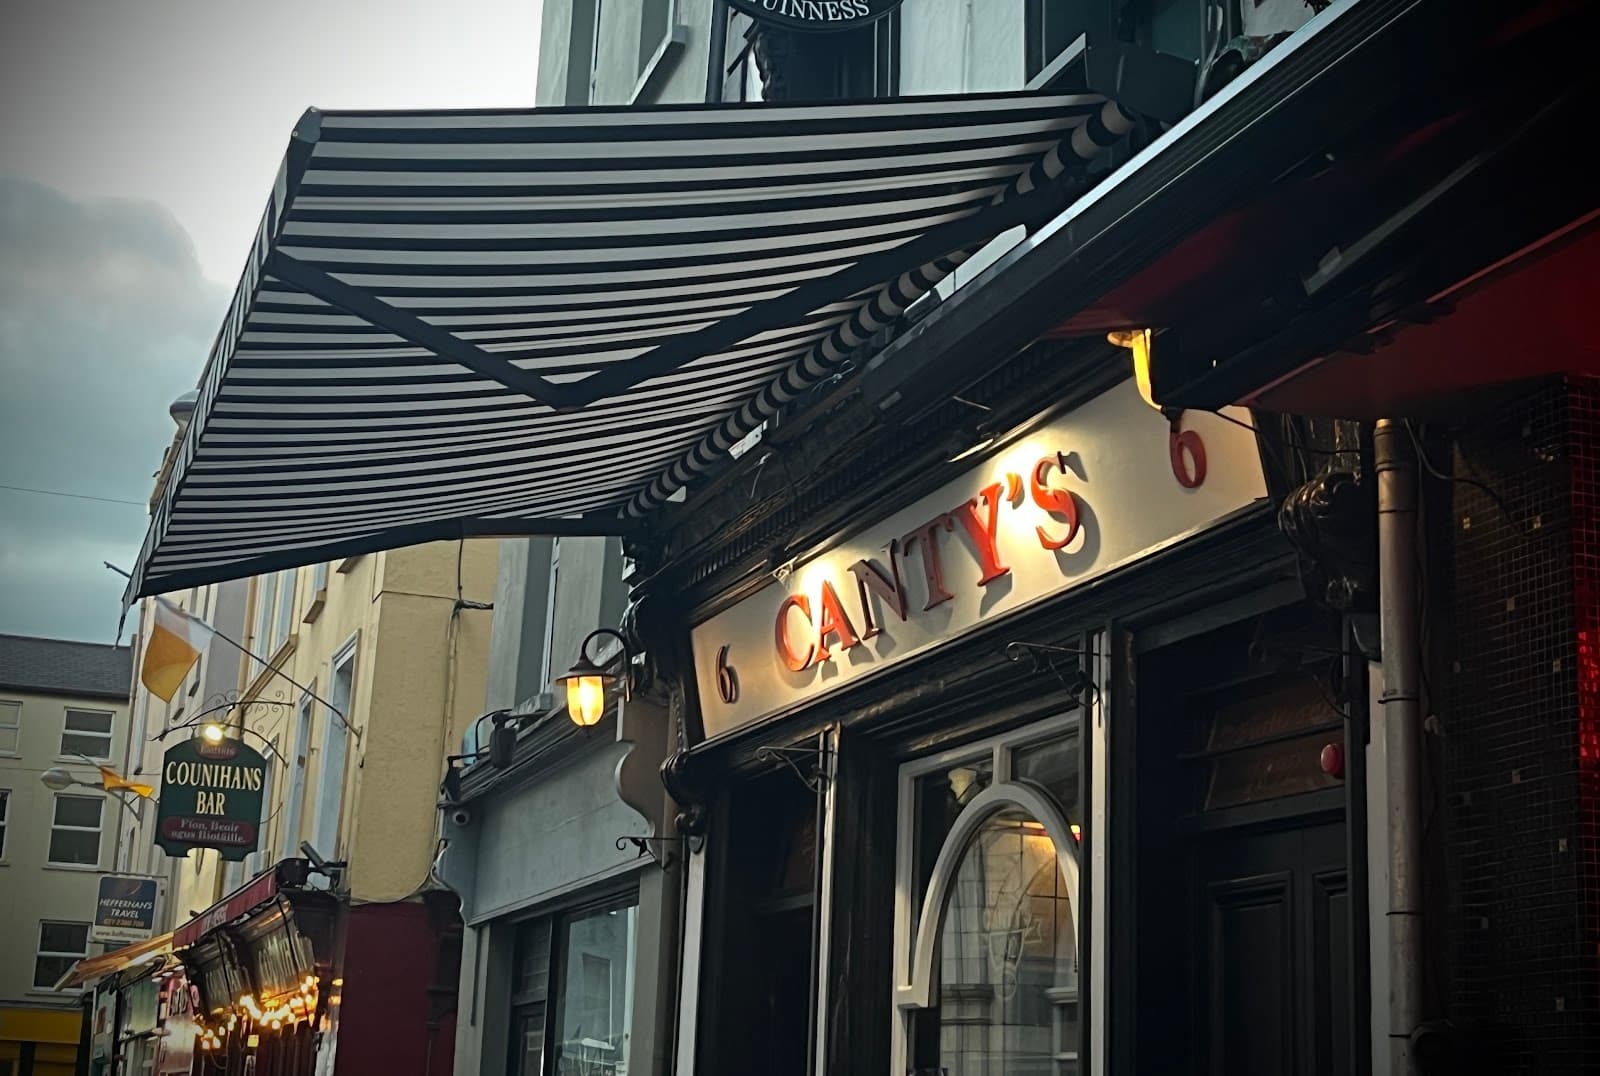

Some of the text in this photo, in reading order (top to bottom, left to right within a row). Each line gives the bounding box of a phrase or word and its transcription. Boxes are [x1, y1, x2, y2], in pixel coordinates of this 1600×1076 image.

[748, 0, 870, 21] UINNESS
[715, 643, 739, 704] 6
[775, 450, 1081, 673] CANTY'S
[166, 761, 261, 791] COUNIHANS
[196, 791, 226, 815] BAR
[111, 908, 139, 919] TRAVEL
